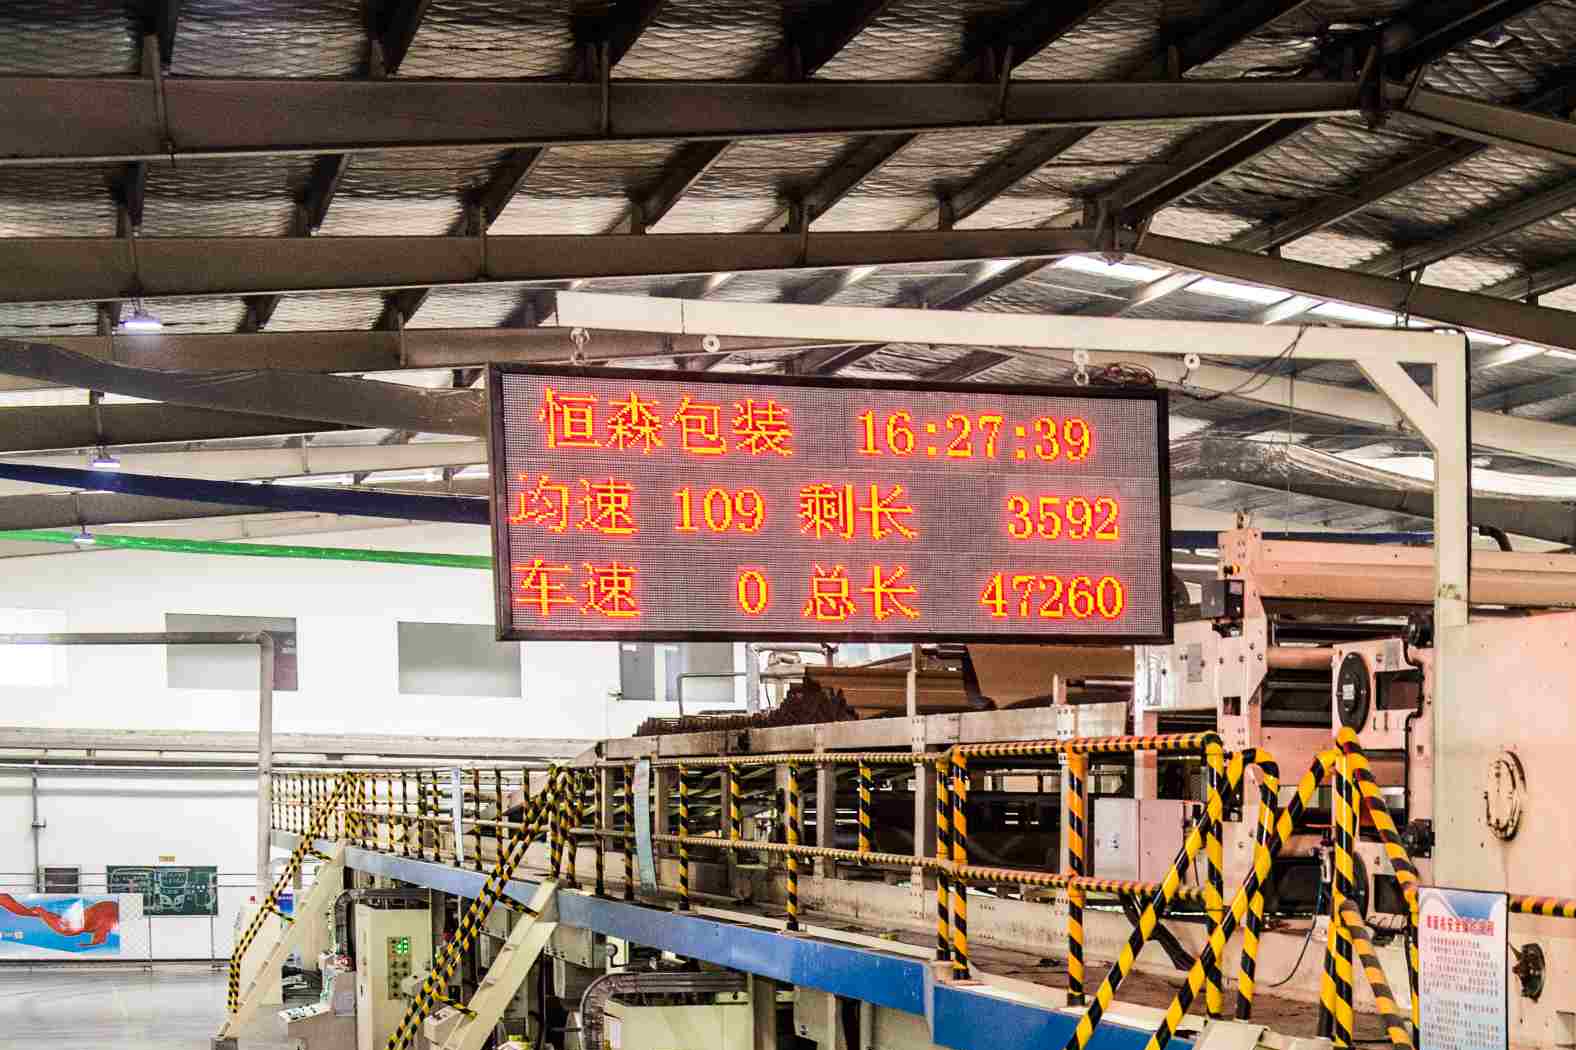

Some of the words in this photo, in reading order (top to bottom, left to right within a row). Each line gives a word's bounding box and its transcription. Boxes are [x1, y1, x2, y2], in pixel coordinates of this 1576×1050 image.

[537, 387, 794, 456] 恒森包装
[856, 408, 1091, 461] 16:27:39
[508, 472, 639, 534] 均速
[673, 486, 766, 532] 109
[798, 482, 919, 540] 剩长
[1006, 494, 1121, 541] 3592
[512, 559, 642, 618] 车速
[735, 569, 770, 616] 0
[801, 562, 921, 621] 总长
[979, 571, 1126, 619] 47260
